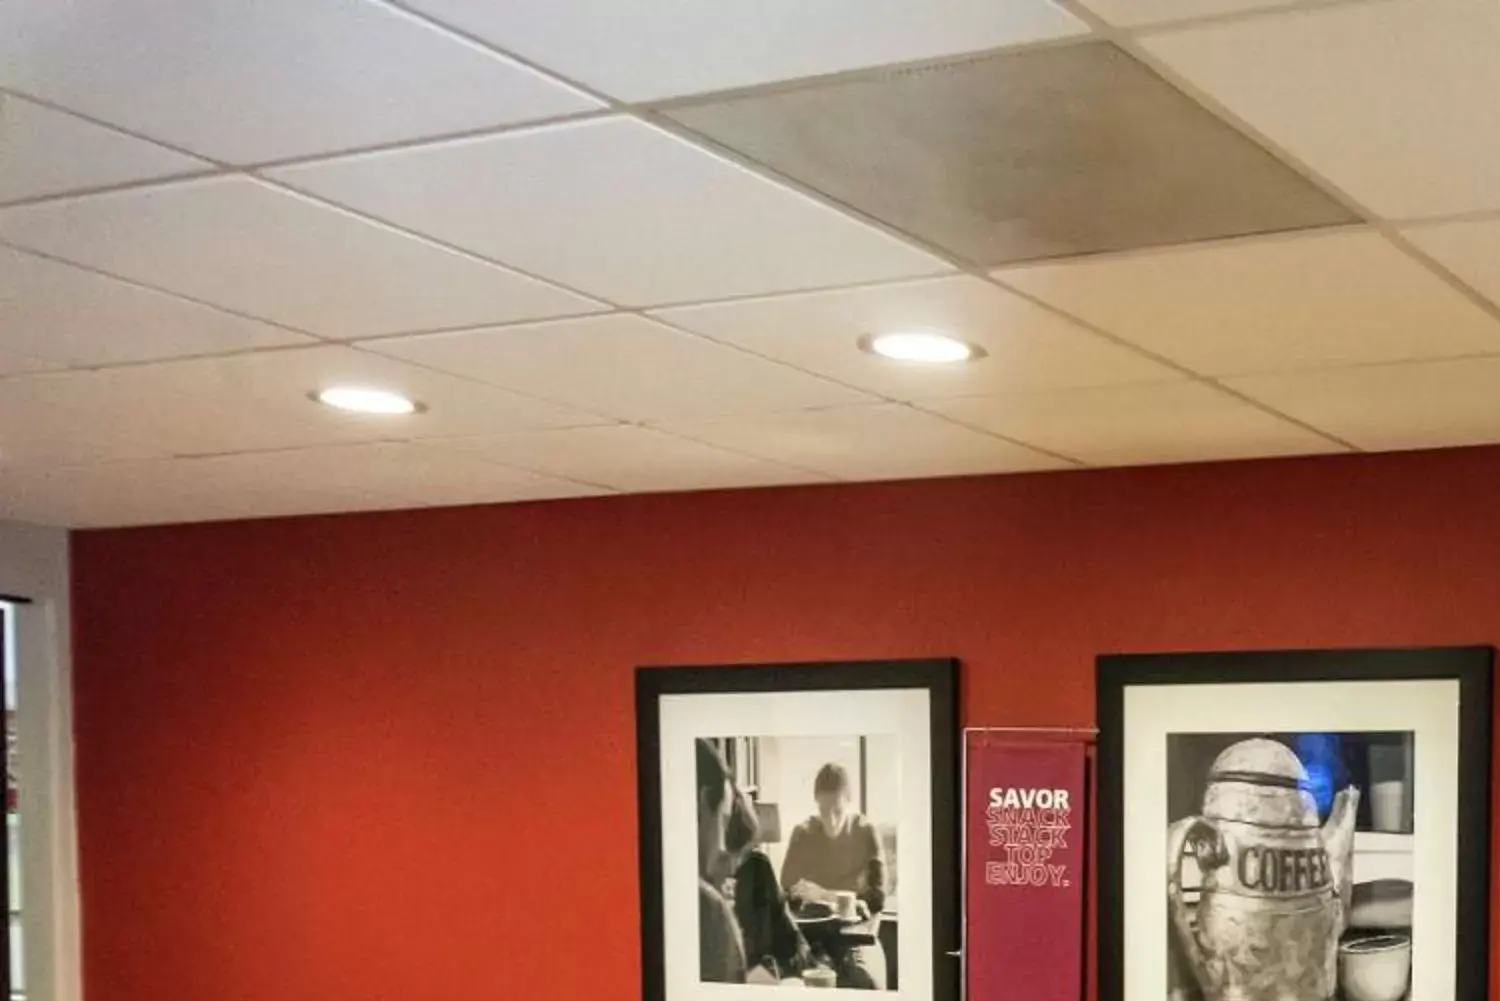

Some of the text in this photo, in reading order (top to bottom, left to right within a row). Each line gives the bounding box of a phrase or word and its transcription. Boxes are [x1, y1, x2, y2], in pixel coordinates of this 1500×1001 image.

[989, 787, 1069, 809] SAVOR
[986, 806, 1072, 828] SNACK
[989, 825, 1068, 848] STACK
[1003, 843, 1053, 865] TOP
